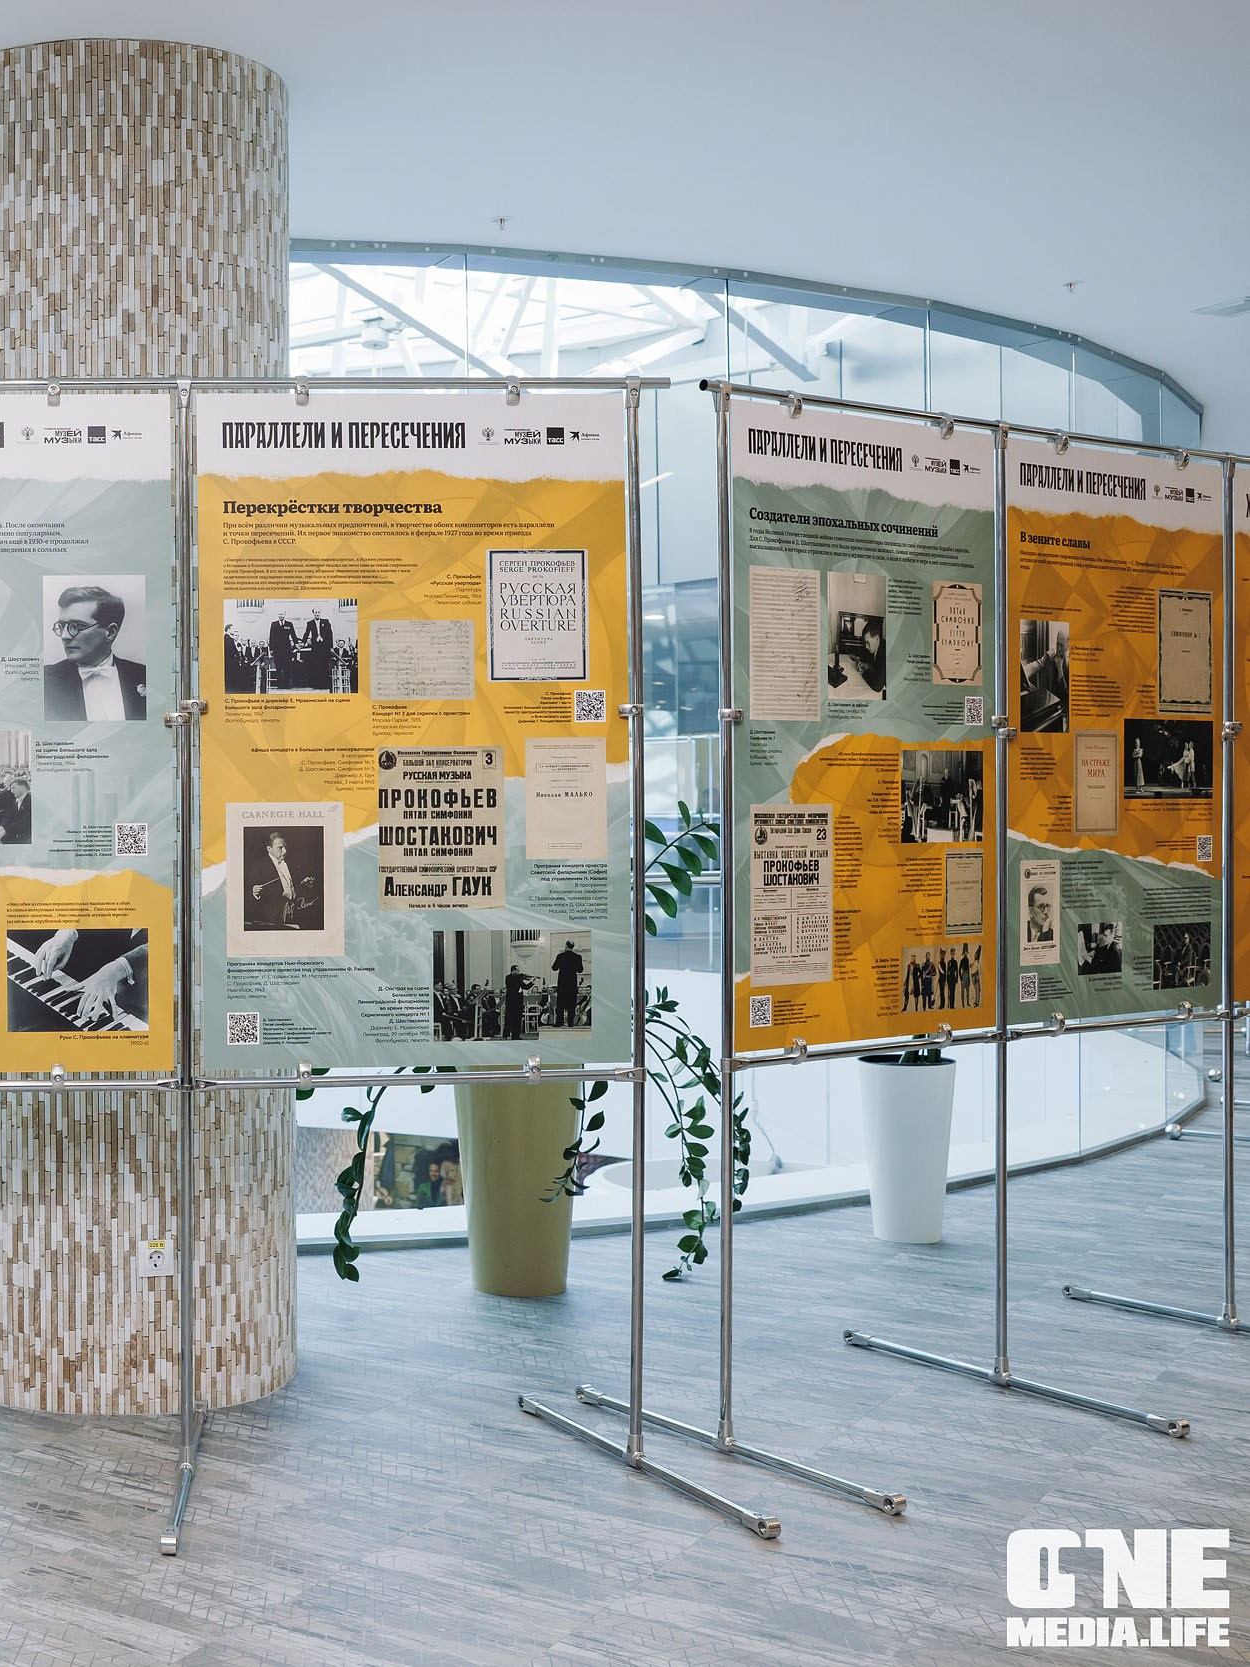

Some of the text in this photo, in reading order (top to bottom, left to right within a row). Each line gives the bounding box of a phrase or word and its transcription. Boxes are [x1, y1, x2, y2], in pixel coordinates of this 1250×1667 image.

[53, 429, 82, 437] МУЗЕЙ
[222, 422, 465, 448] ПАРАЛЛЕЛИ И ПЕРЕСЕЧЕНИЯ
[513, 430, 541, 438] МУЗЕЙ
[748, 428, 902, 472] ПАРАЛЛЕЛИ И ПЕРЕСЕЧЕНИЯ
[1020, 462, 1146, 500] ПАРАЛЛЕЛИ И ПЕРЕСЕЧЕНИЯ
[223, 500, 442, 517] Перекрёстки творчества
[749, 507, 938, 537] Создатели эпохальных сочинений
[1020, 531, 1090, 549] В зените славы
[500, 583, 576, 594] РУССКАЯ
[500, 594, 576, 607] УВЕРТЮРА
[500, 608, 576, 620] RUSSIAN
[500, 620, 576, 631] OVERTURE
[486, 752, 493, 765] 3
[403, 771, 472, 780] РУССКАЯ МУЗЫКА
[1087, 769, 1105, 778] МИРА
[379, 788, 496, 808] ПРОКОФЬЕВ
[403, 810, 472, 819] ПЯТАЯ СИМФОНИЯ
[379, 826, 497, 846] ШОСТАКОВИЧ
[817, 828, 827, 840] 23
[404, 847, 473, 856] ПЯТАЯ СИМФОНИЯ
[764, 860, 819, 874] ПРОКОФЬЕВ
[764, 873, 819, 886] ШОСТАКОВИЧ
